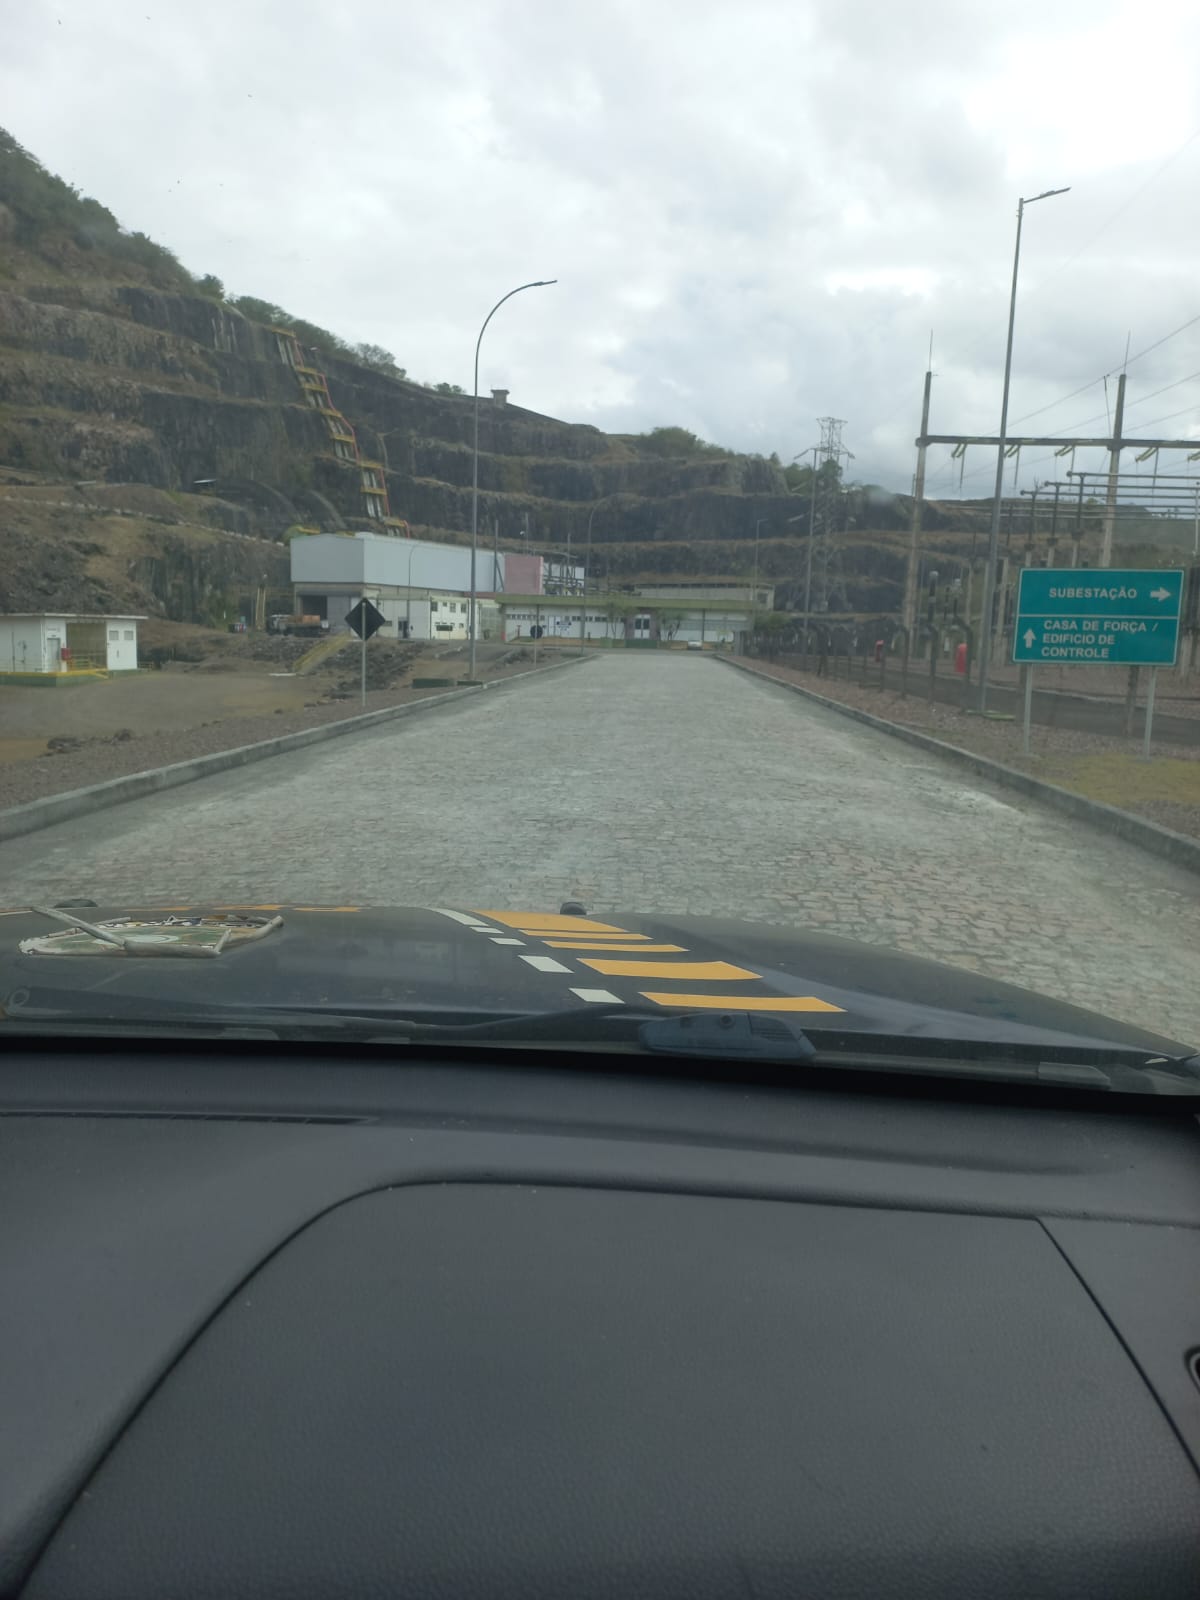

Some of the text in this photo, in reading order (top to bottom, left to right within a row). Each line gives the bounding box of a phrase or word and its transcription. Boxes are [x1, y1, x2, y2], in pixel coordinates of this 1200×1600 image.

[1049, 586, 1137, 600] SUBESTAÇÃO
[1043, 620, 1078, 631] CASA
[1082, 621, 1099, 631] DE
[1103, 622, 1147, 634] FORÇA
[1098, 635, 1115, 645] DE
[1042, 647, 1109, 658] CONTROLE
